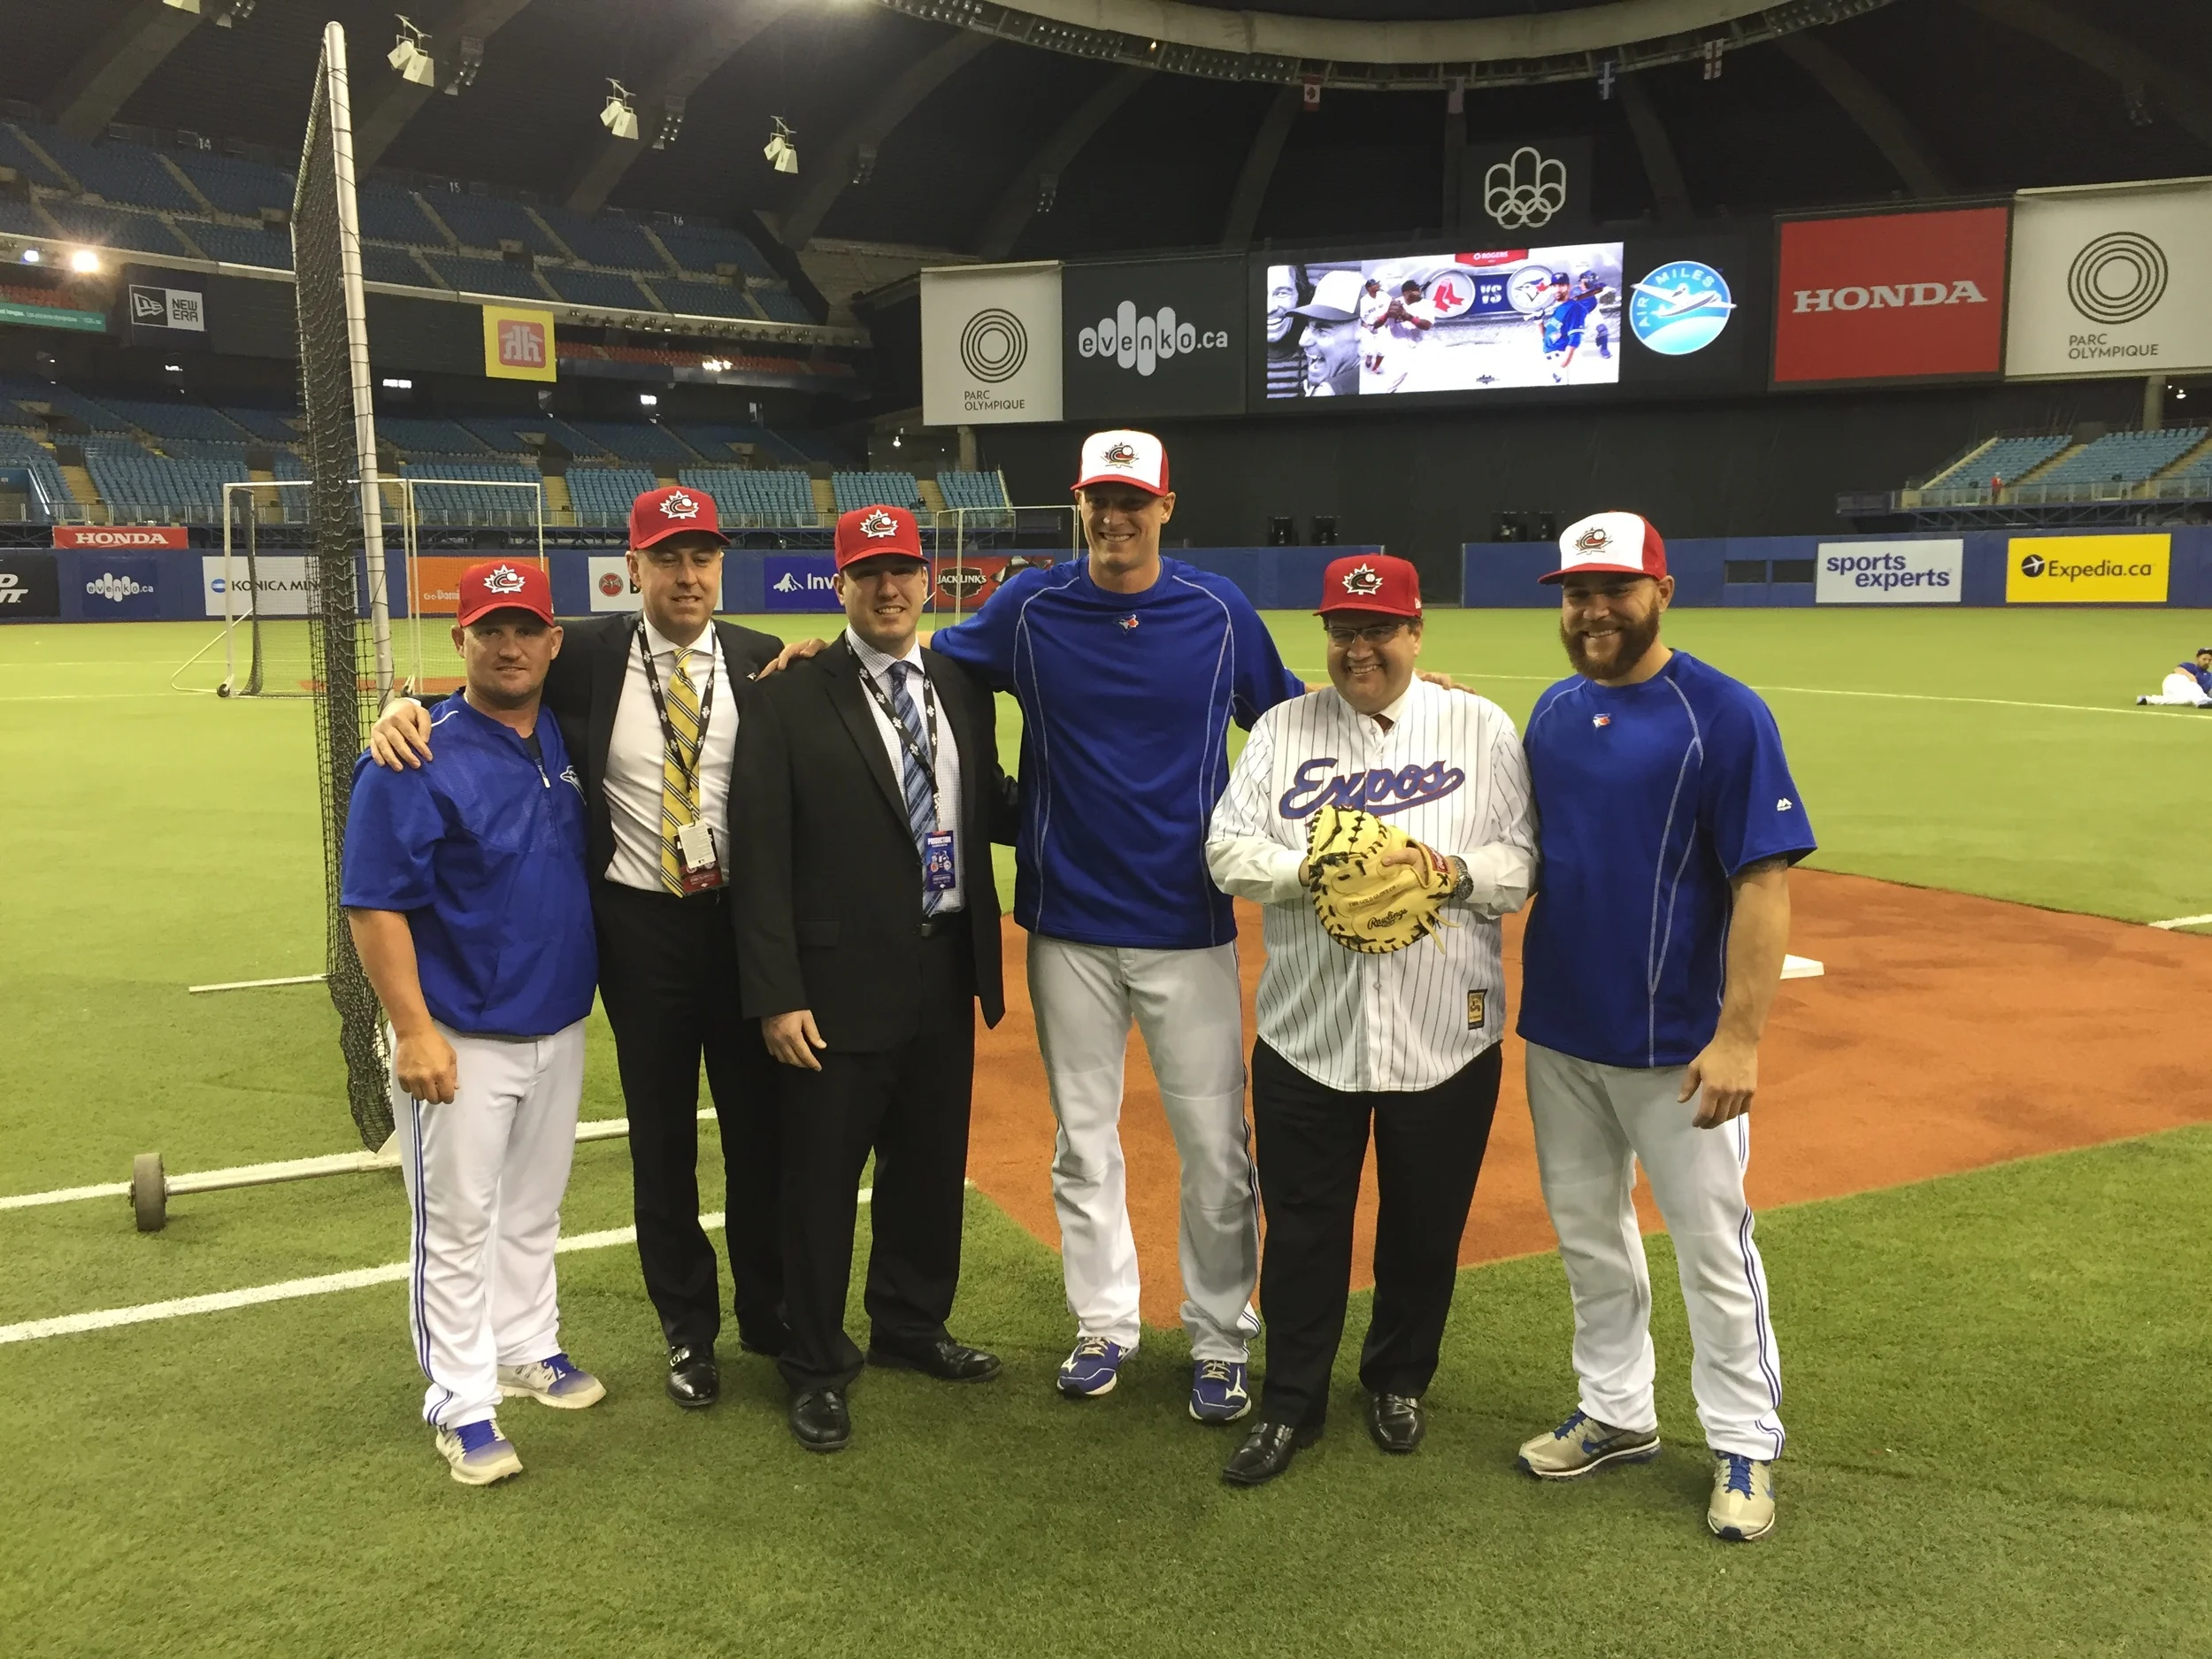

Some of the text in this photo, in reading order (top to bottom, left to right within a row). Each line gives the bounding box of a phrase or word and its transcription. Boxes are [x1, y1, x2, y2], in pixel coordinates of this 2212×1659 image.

[1655, 268, 1715, 288] MILES
[1479, 284, 1502, 304] VS
[1793, 280, 1988, 313] HONDA
[172, 298, 197, 311] NEW
[1637, 296, 1650, 326] AIR
[173, 310, 198, 322] ERA
[2069, 334, 2108, 347] PARC
[2068, 342, 2160, 360] OLYMPIQUE
[964, 390, 991, 401] PARC
[964, 399, 1025, 411] OLYMPIQUE
[75, 533, 169, 545] HONDA
[1826, 552, 1906, 575] sports
[2048, 559, 2152, 582] Expedia.ca
[232, 580, 288, 591] KONICA
[807, 573, 834, 589] Inv
[1855, 569, 1950, 591] experts
[1279, 757, 1465, 819] Expos
[1359, 895, 1373, 904] GOLD
[1373, 887, 1390, 900] GLOVE
[1367, 908, 1409, 930] Rawlings
